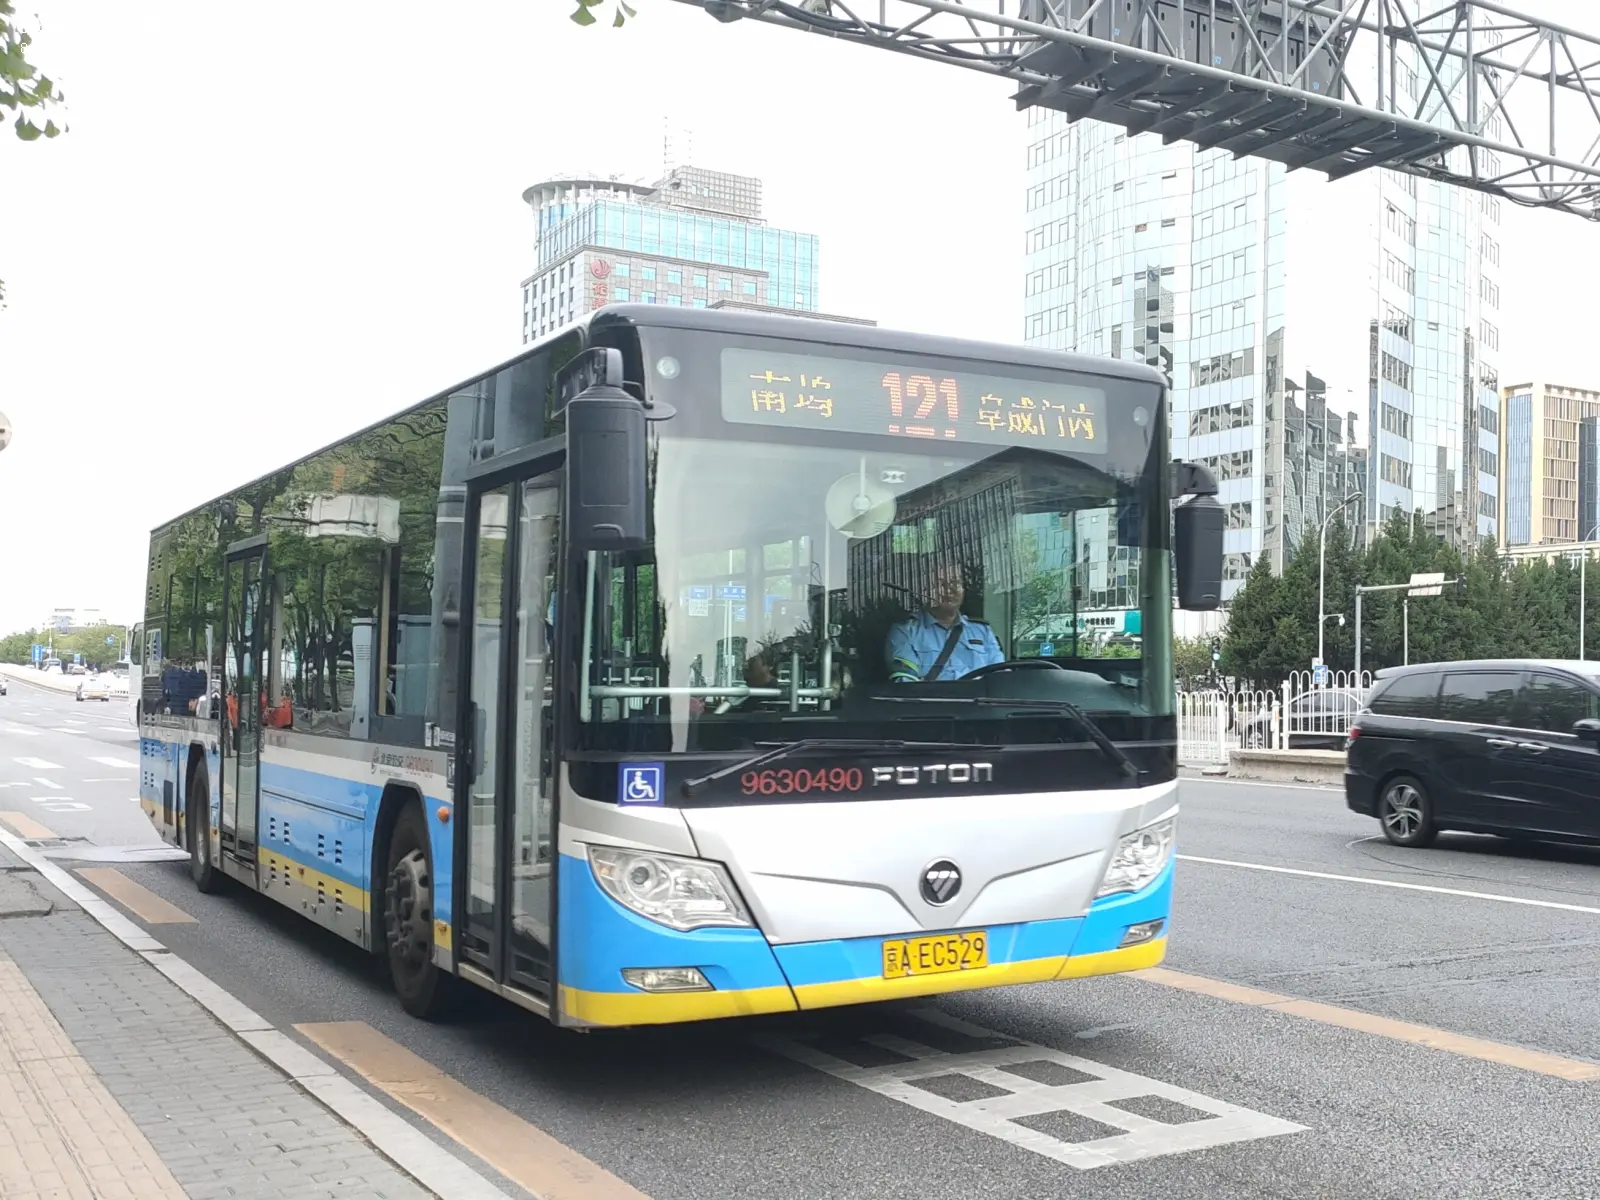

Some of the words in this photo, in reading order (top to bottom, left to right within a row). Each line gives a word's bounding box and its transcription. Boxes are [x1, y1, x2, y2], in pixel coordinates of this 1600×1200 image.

[882, 372, 958, 437] 121
[976, 394, 1095, 440] 阜成门内
[741, 768, 863, 795] 9630490
[871, 762, 993, 786] FOTON
